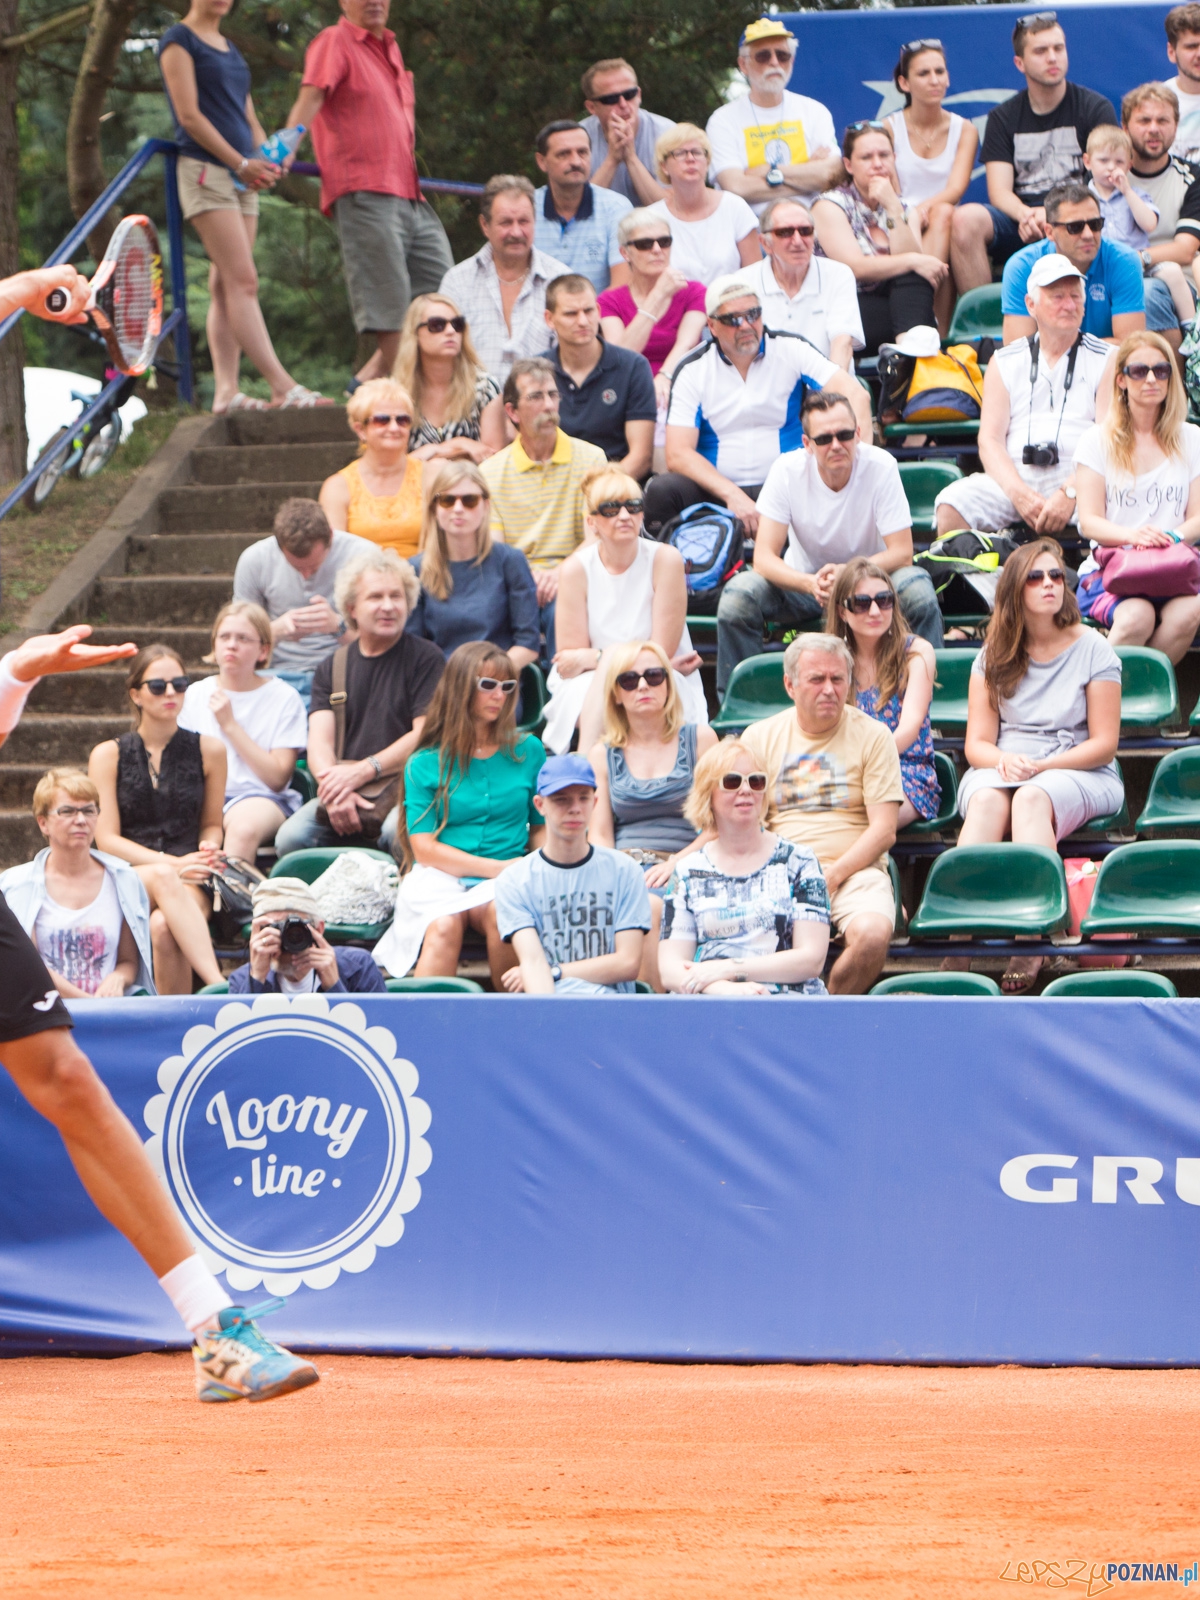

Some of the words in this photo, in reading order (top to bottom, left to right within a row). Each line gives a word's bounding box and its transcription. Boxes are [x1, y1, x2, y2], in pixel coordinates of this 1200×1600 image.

[1146, 482, 1183, 518] Grey
[206, 1090, 368, 1159] Loony
[251, 1154, 326, 1197] line
